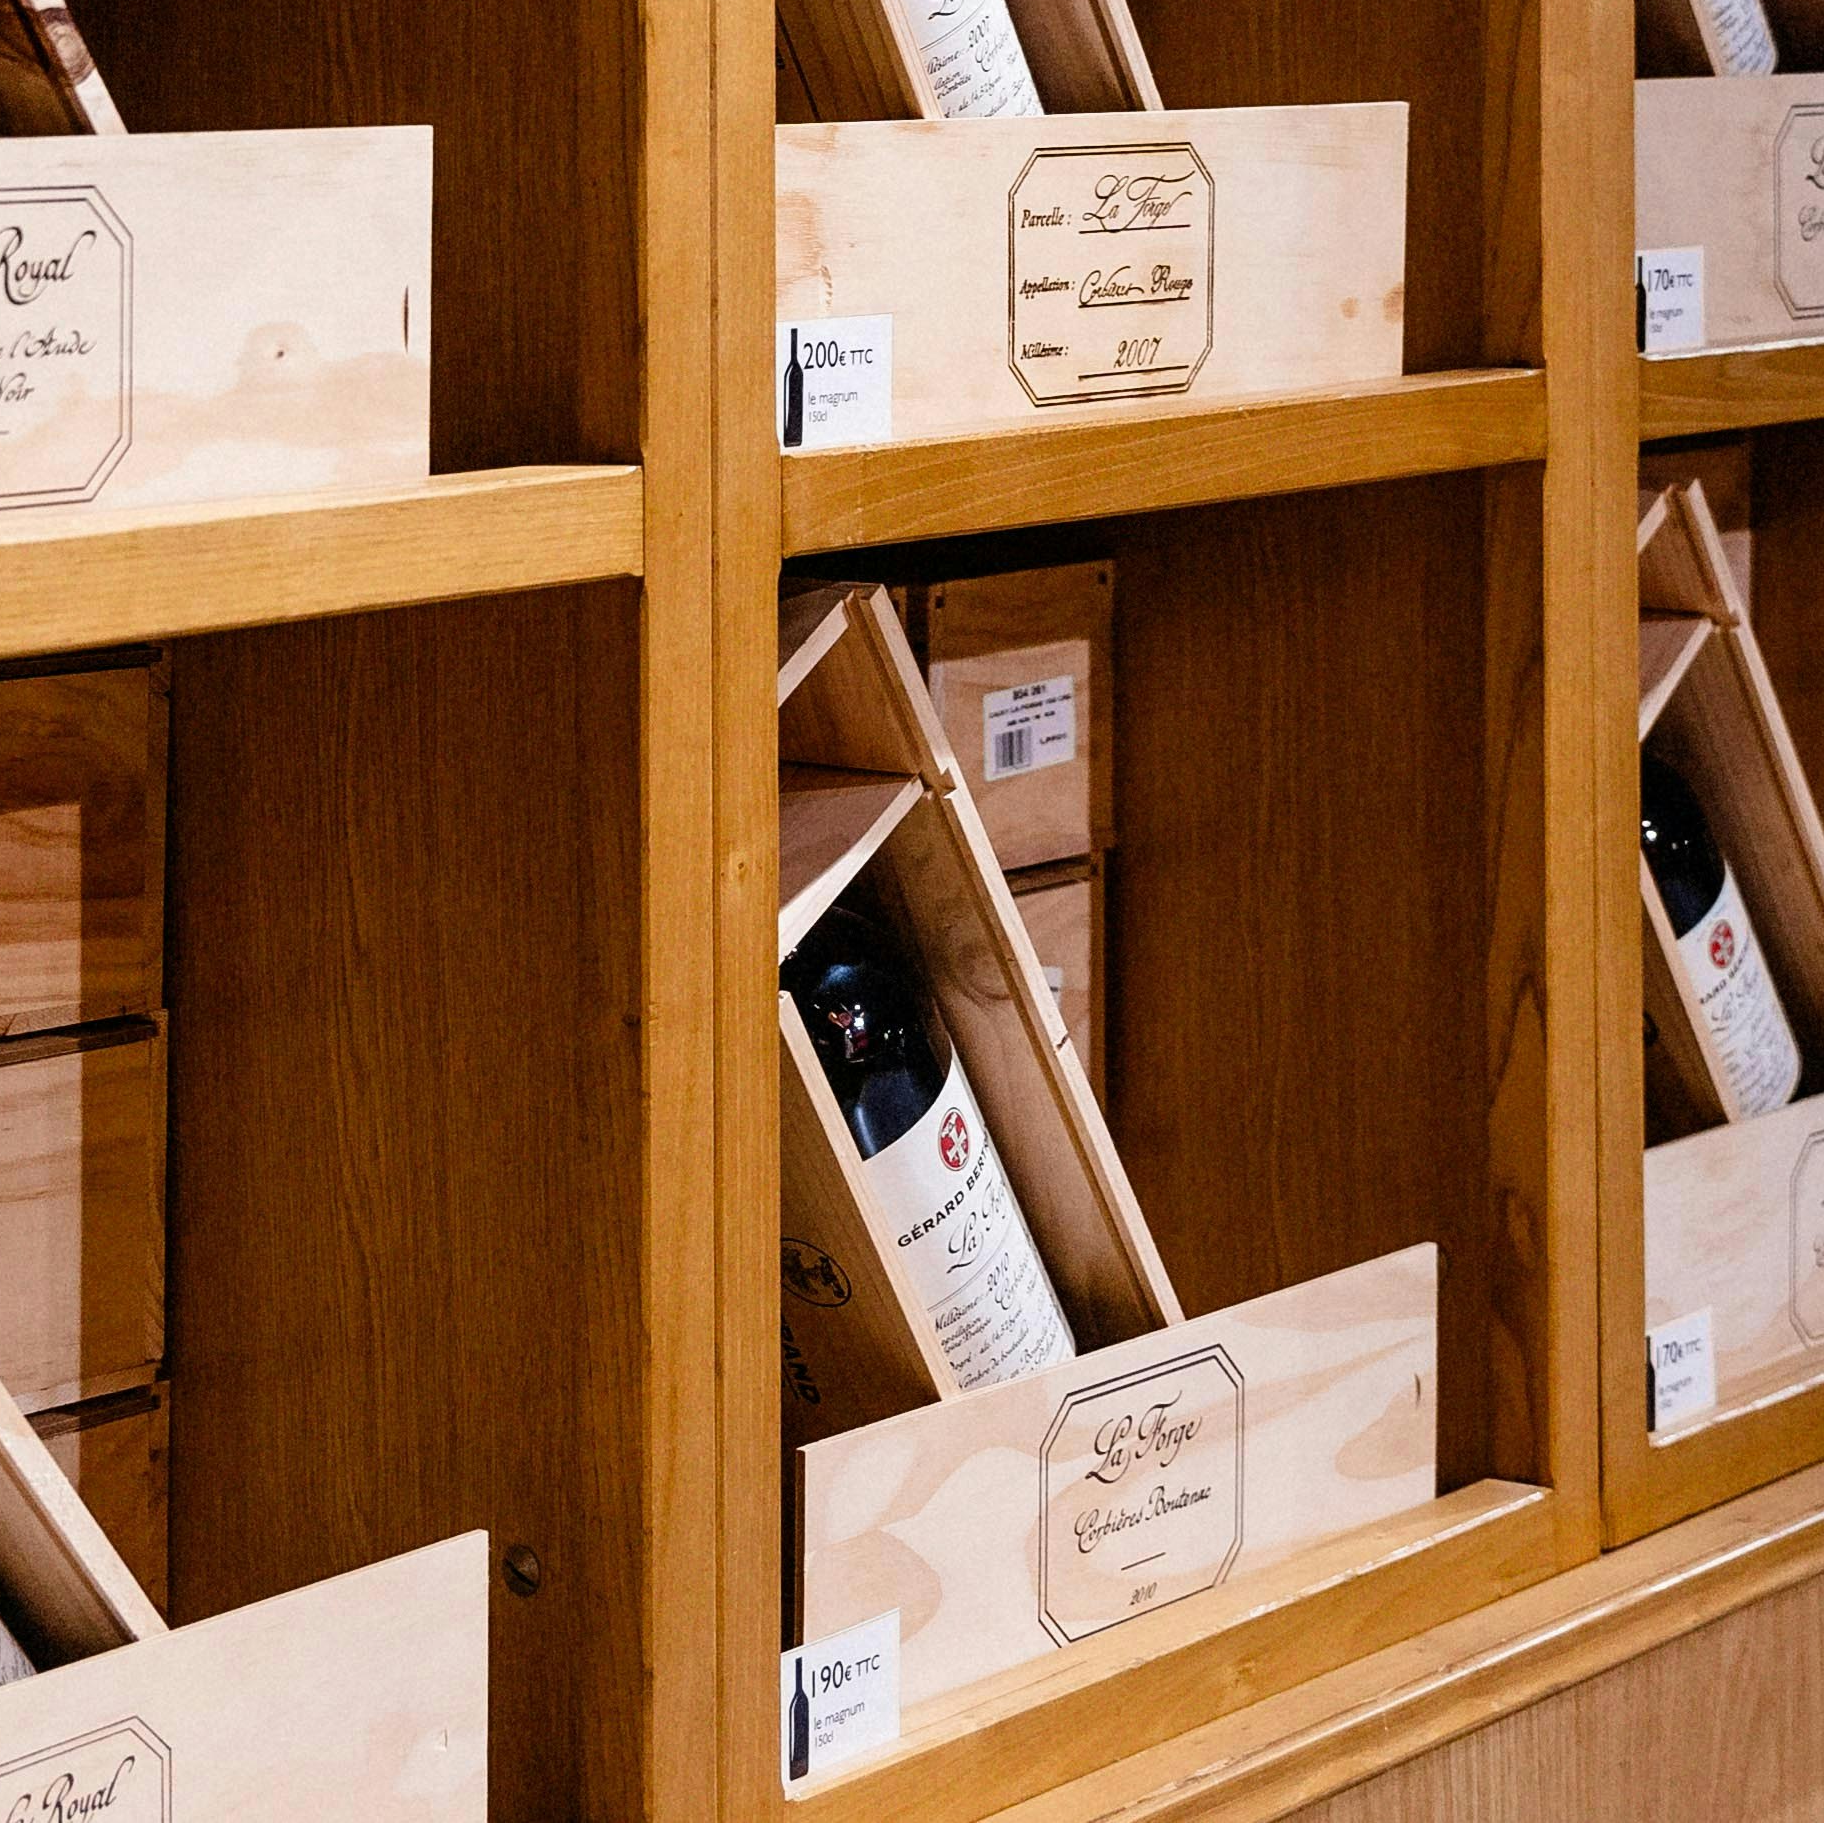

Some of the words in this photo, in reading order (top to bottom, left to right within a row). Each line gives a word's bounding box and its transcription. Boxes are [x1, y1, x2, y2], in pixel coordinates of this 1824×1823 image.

[1082, 174, 1128, 233] La
[1126, 170, 1196, 229] Forge
[803, 340, 847, 370] 200€
[849, 347, 874, 366] TTC
[1113, 336, 1163, 369] 2007
[897, 1190, 965, 1248] GÉRARD
[946, 1211, 985, 1274] La
[1085, 1414, 1131, 1484] La
[1135, 1389, 1204, 1469] Forge
[1074, 1507, 1144, 1554] Corbières
[1145, 1484, 1212, 1522] Boutenac
[811, 1660, 853, 1699] 190€
[855, 1654, 881, 1677] TTC
[42, 1755, 135, 1823] Royal
